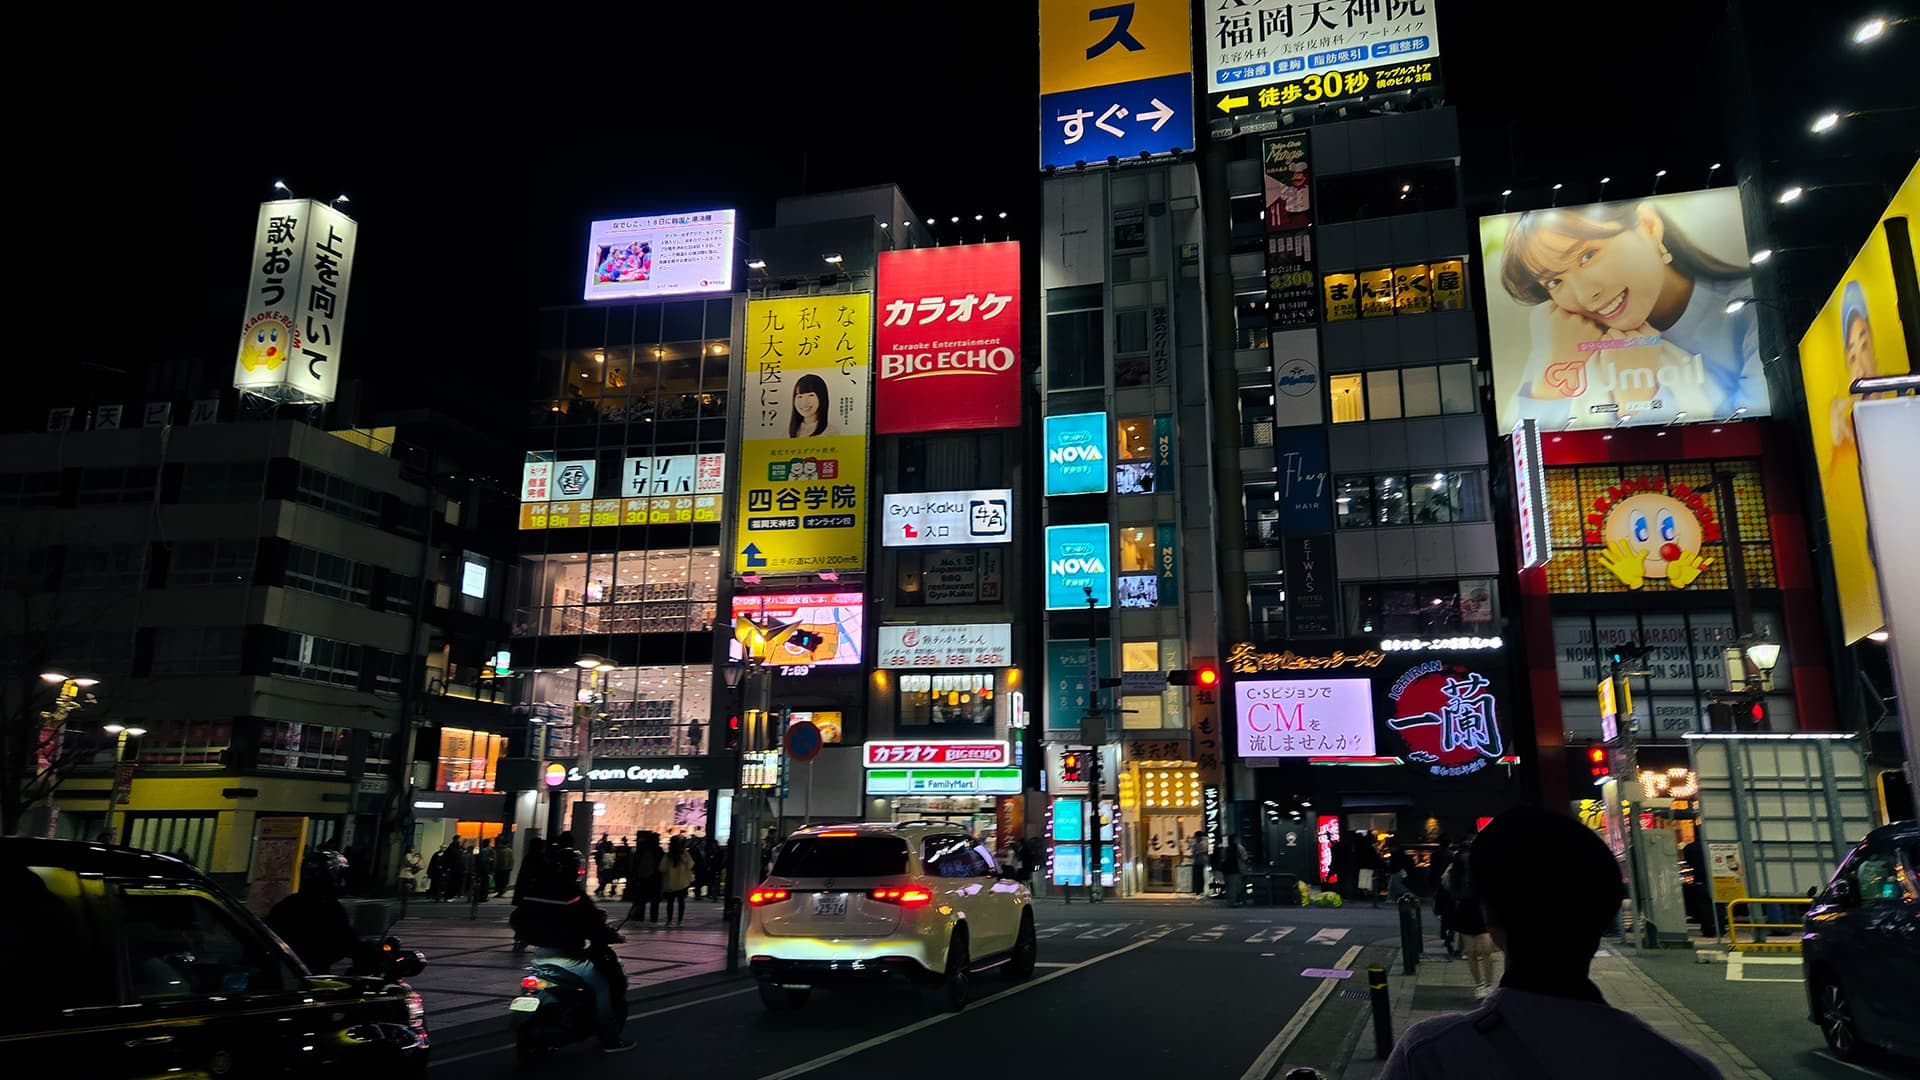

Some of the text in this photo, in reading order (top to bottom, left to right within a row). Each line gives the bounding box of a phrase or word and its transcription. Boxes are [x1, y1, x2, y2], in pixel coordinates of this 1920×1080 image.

[1086, 3, 1146, 60] ス
[1258, 71, 1370, 108] 徒歩30秒
[1057, 103, 1129, 145] すぐ
[261, 216, 298, 306] 歌おう
[303, 225, 344, 380] 上を向いて
[883, 293, 1013, 327] カラオケ
[798, 306, 822, 356] 私が
[835, 305, 857, 385] なんで、
[892, 337, 1000, 352] Karaoke Entertainment
[881, 346, 1015, 380] BIG ECHO
[1051, 445, 1103, 465] NOVA
[1160, 436, 1169, 466] NOVA
[634, 459, 670, 475] トリ
[748, 484, 857, 512] 四谷学院
[889, 502, 965, 527] Gyu-Kaku
[975, 507, 1003, 528] 牛角
[925, 526, 950, 538] 入口
[1051, 558, 1105, 577] NOVA
[1162, 547, 1173, 578] NOVA
[1577, 629, 1626, 644] JUMBO
[1388, 660, 1443, 701] ICHIRAN
[1387, 673, 1504, 758] 一蘭
[873, 746, 939, 762] カラオケ
[627, 764, 689, 783] Capsule
[927, 779, 975, 790] FamilyMart
